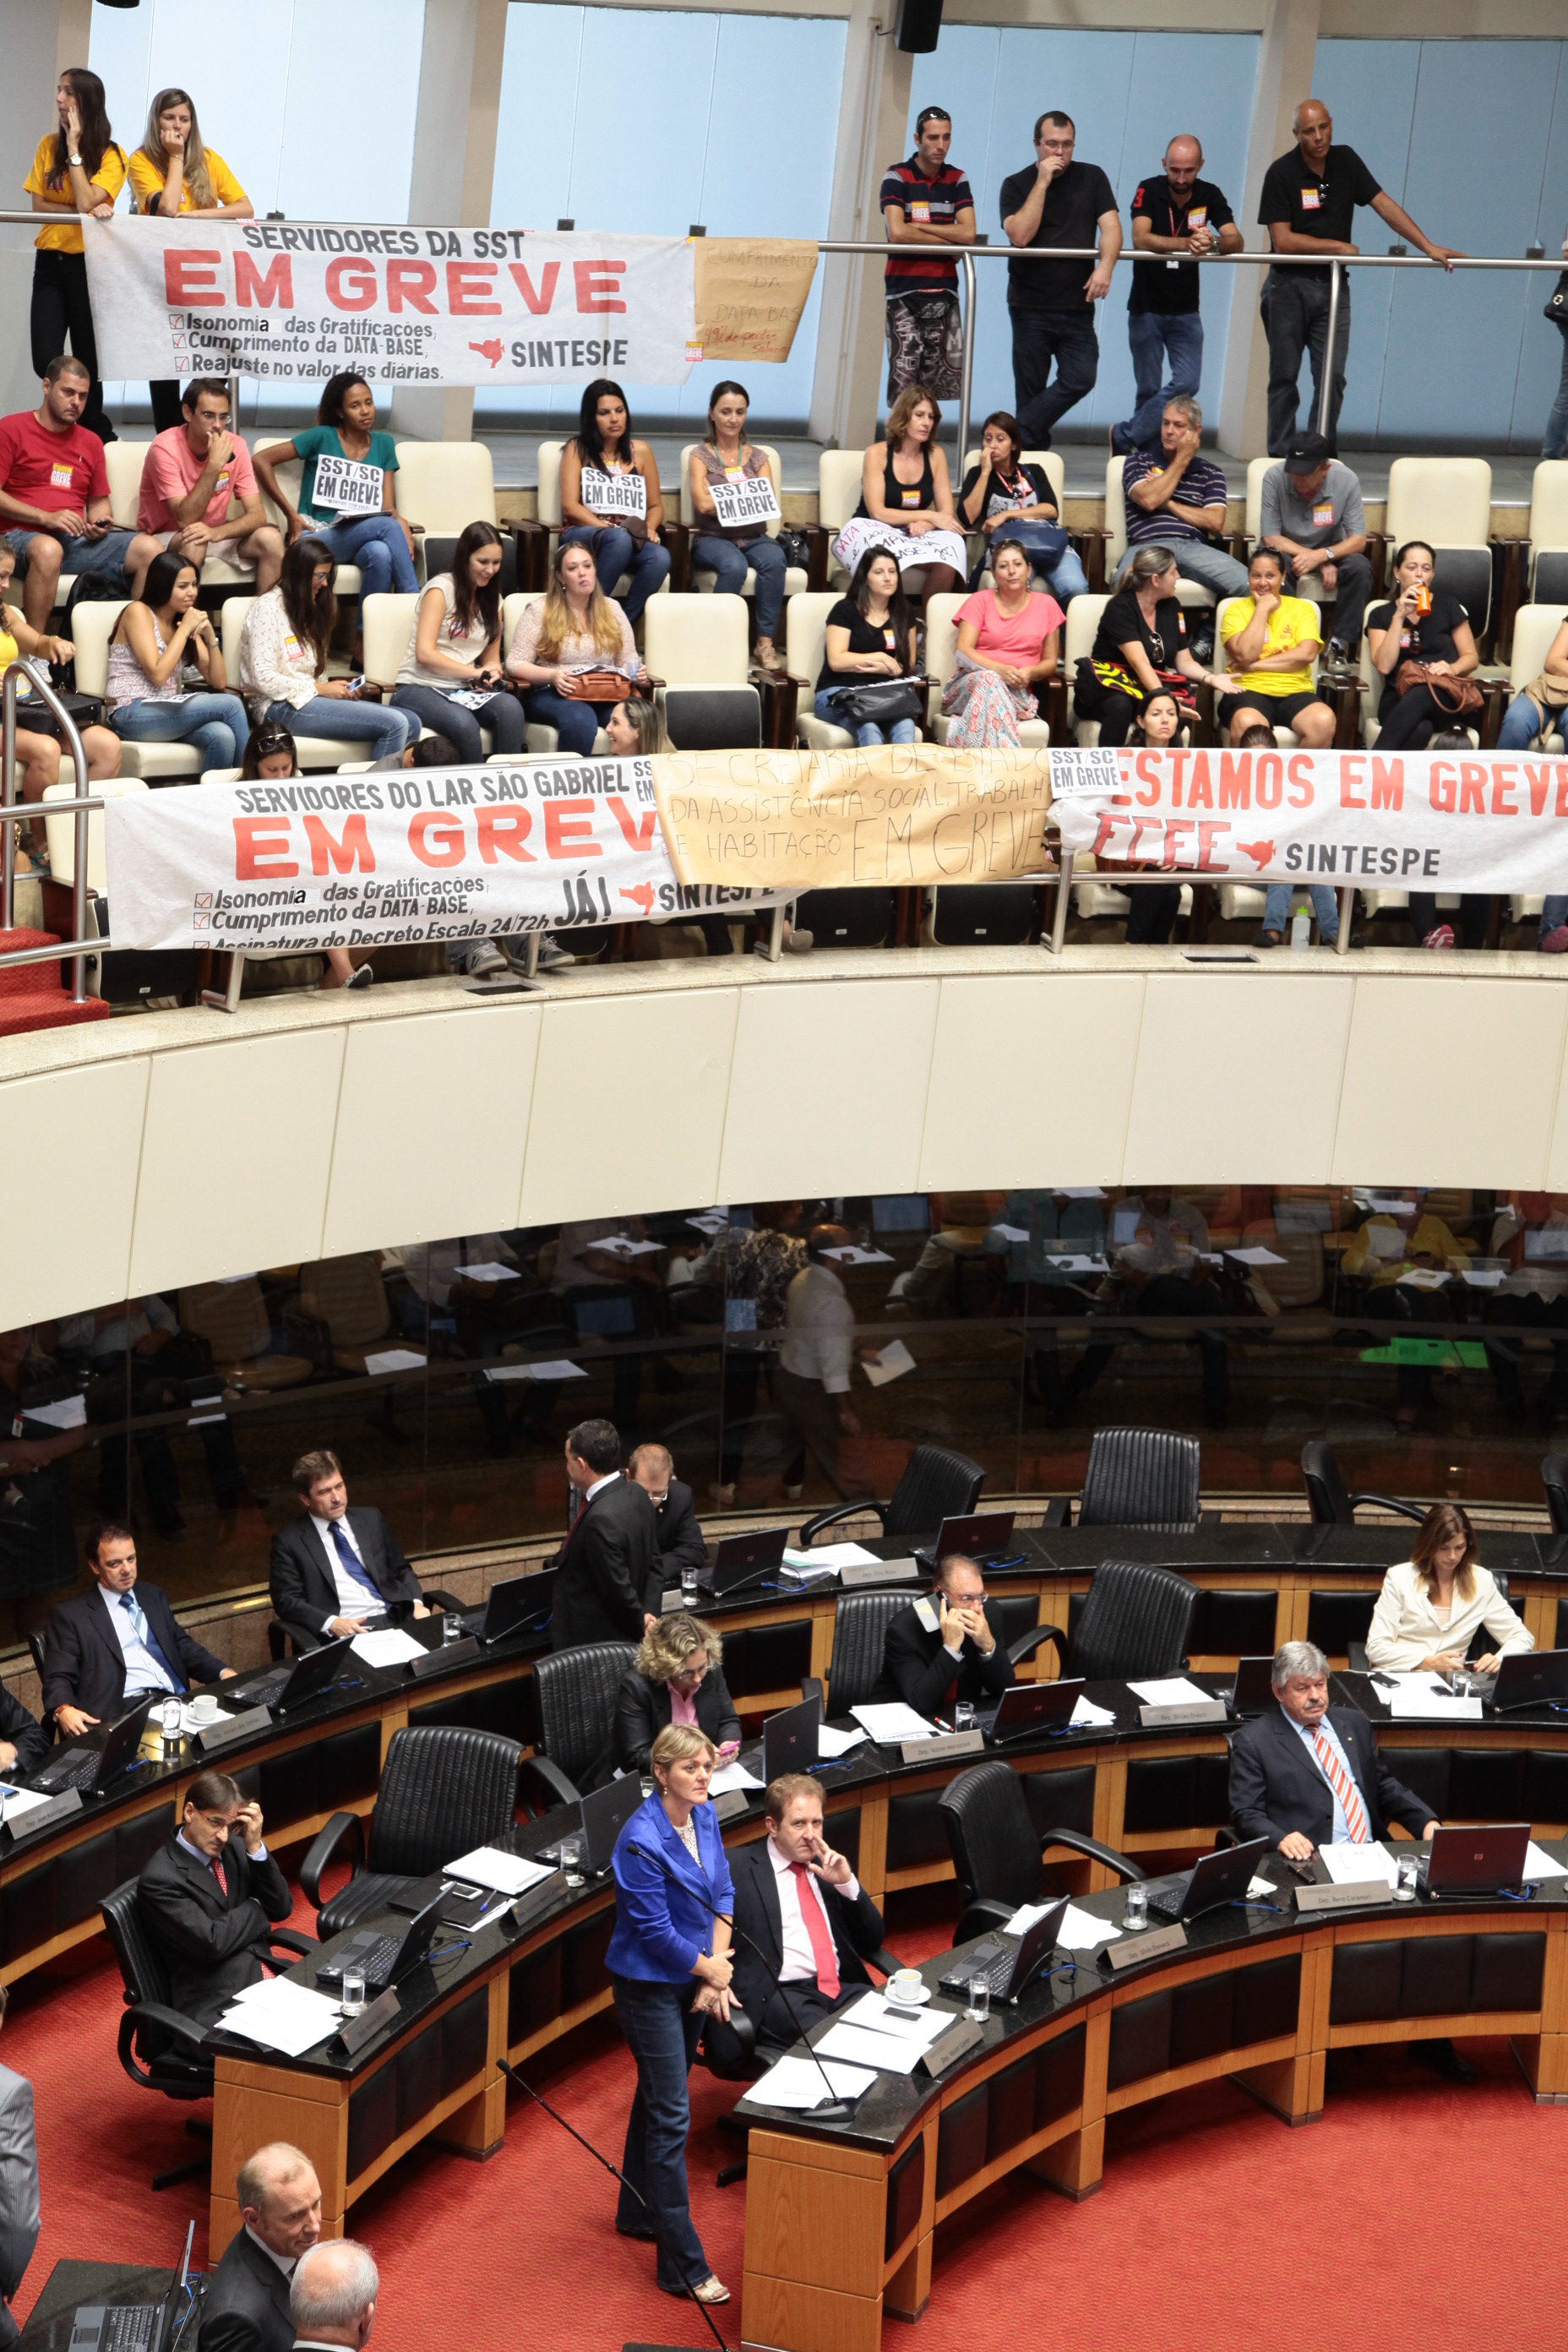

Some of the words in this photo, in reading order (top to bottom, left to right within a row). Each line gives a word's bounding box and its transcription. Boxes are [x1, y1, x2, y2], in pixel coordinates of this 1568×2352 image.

[242, 226, 419, 254] SERVIDORES
[426, 231, 462, 258] DA
[473, 231, 525, 259] SST
[164, 248, 294, 309] EM
[325, 255, 627, 315] GREVE
[749, 275, 780, 288] DA
[187, 313, 269, 333] Isonomia
[285, 316, 315, 335] das
[188, 331, 310, 353] Cumprimento
[315, 335, 337, 353] da
[510, 339, 629, 368] SINTESPE
[192, 354, 270, 376] Reajuste
[274, 362, 294, 377] no
[297, 359, 340, 378] valor
[345, 361, 377, 378] das
[320, 457, 380, 483] SST/SC
[316, 475, 337, 498] EM
[339, 478, 380, 507] GREVE
[585, 484, 603, 504] EM
[607, 486, 644, 510] GREVE
[712, 479, 769, 498] SST/SC
[717, 498, 738, 520] EM
[737, 494, 777, 517] GREVE
[891, 744, 936, 774] DE
[1051, 749, 1113, 765] SST/SC
[235, 782, 381, 814] SERVIDORES
[388, 781, 422, 810] DO
[427, 777, 477, 807] LAR
[480, 770, 529, 803] SÃO
[533, 763, 631, 798] GABRIEL
[635, 780, 656, 802] EM
[1053, 767, 1075, 788] EM
[1077, 766, 1119, 787] GREVE
[1111, 749, 1315, 810] ESTAMOS
[1339, 754, 1405, 812] EM
[670, 798, 700, 823] DA
[232, 814, 376, 881] EM
[675, 834, 689, 855] E
[706, 828, 843, 863] HABITAÇÃO
[853, 814, 914, 881] EM
[933, 808, 1048, 875] GREVE
[1285, 842, 1441, 877] SINTESPE
[214, 888, 306, 910] Isonomia
[323, 882, 358, 902] das
[321, 930, 346, 948] do
[347, 923, 423, 947] Decreto
[426, 918, 485, 940] Escala
[553, 869, 612, 928] JÁ!
[211, 901, 347, 934] Cumprimento
[351, 901, 377, 920] da
